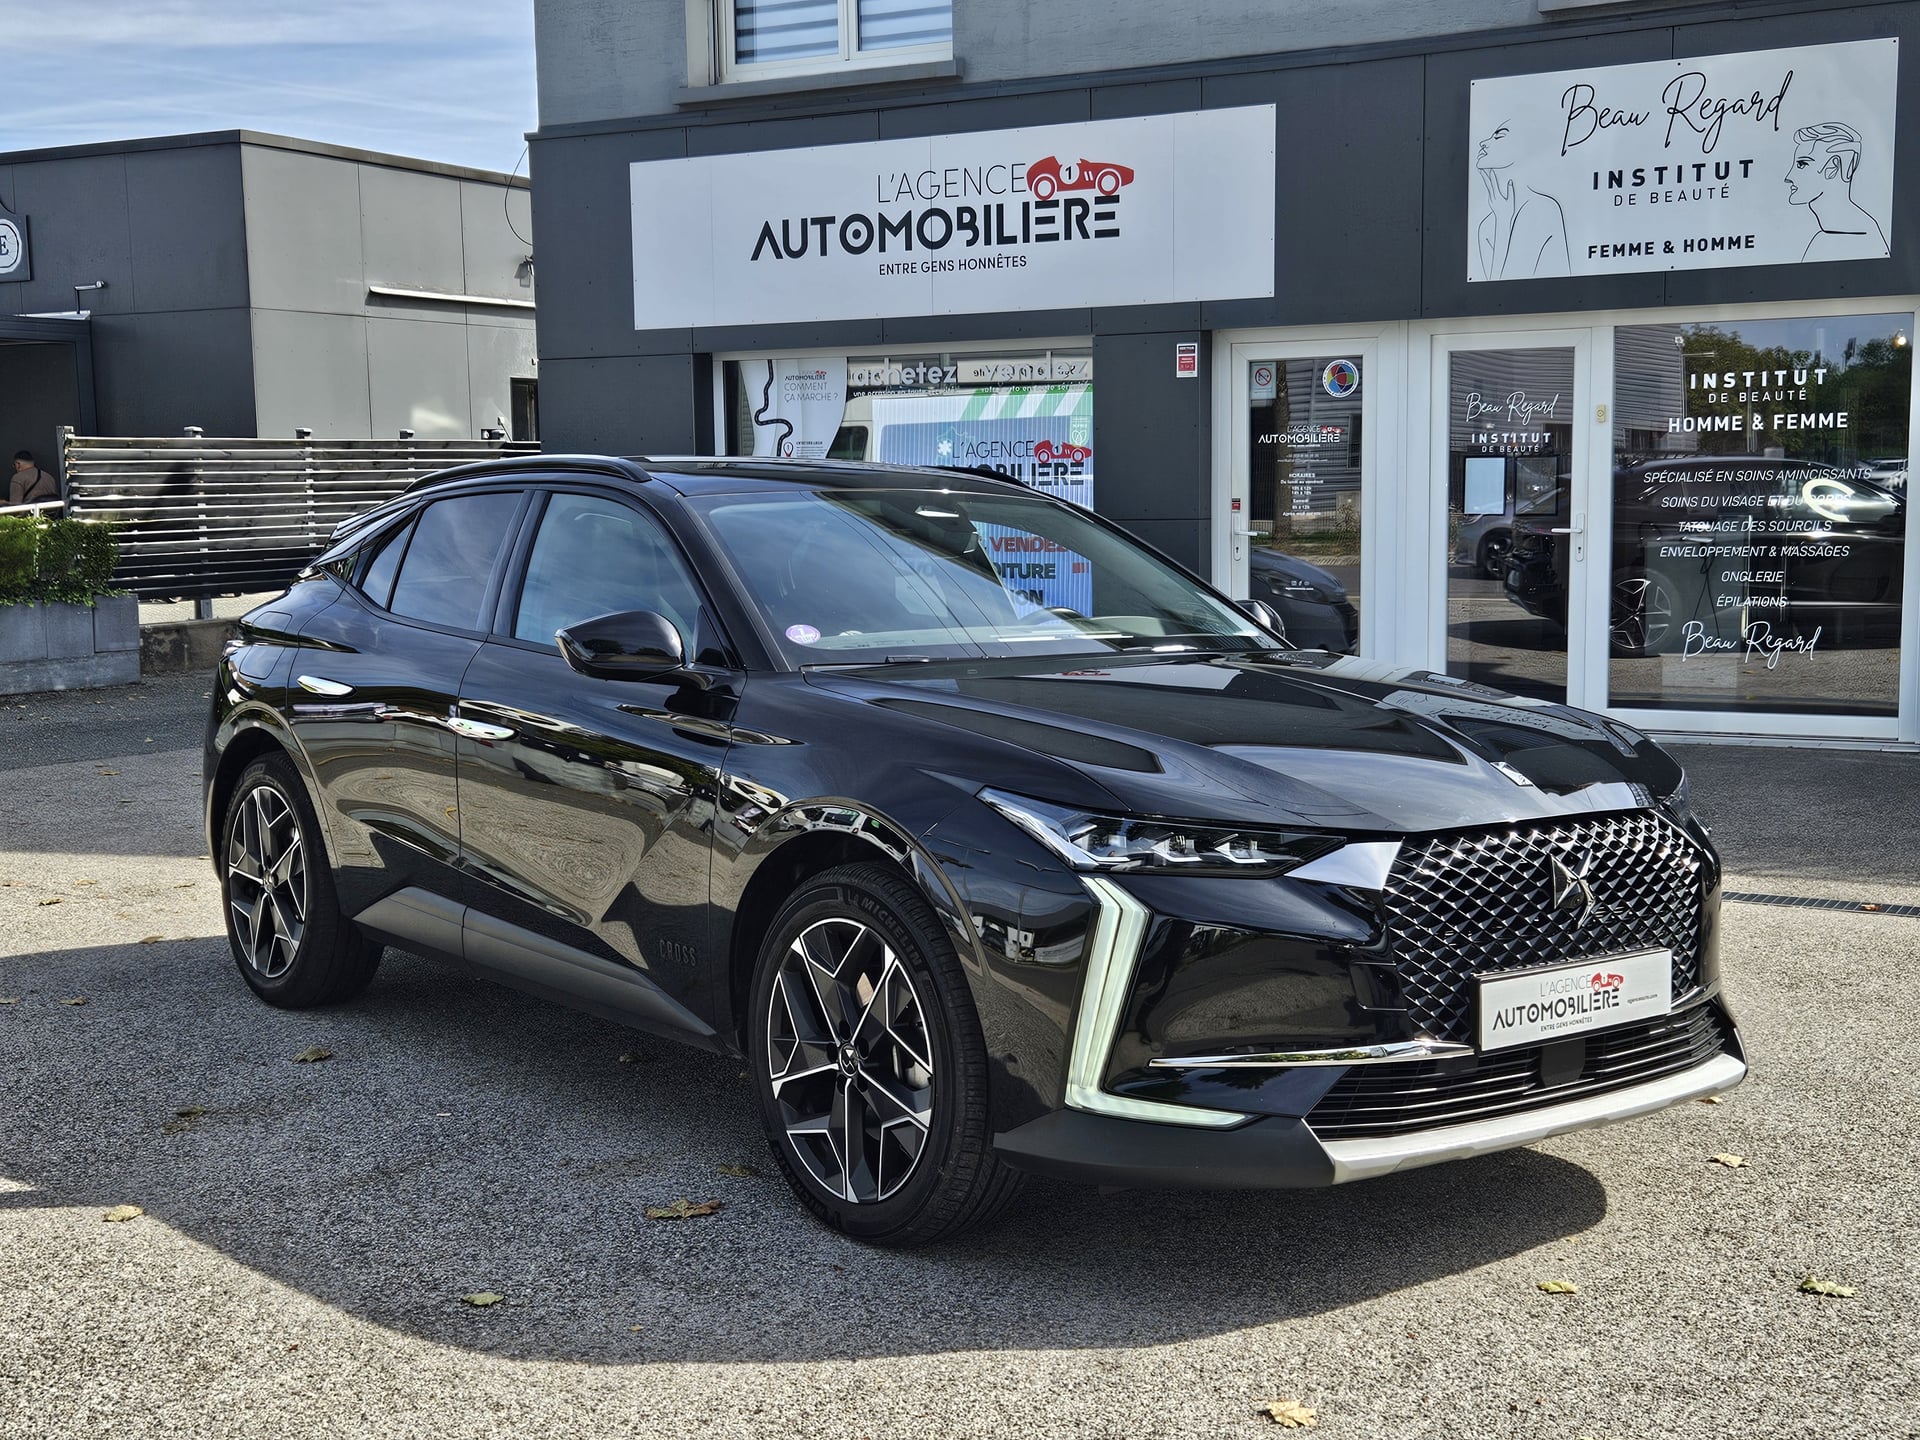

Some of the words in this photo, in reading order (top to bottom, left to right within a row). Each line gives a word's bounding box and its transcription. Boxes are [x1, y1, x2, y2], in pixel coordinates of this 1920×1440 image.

[1560, 83, 1649, 156] Beau
[1662, 70, 1794, 154] Regard
[877, 162, 1026, 204] L'AGENCE
[1593, 159, 1754, 190] INSTITUT
[1614, 193, 1637, 206] DE
[1650, 183, 1729, 204] BEAUTÉ
[1588, 241, 1654, 259] FEMME
[1663, 240, 1675, 254] &
[1683, 235, 1755, 253] HOMME
[879, 262, 917, 275] ENTRE
[920, 260, 954, 273] GENS
[958, 253, 1027, 271] HONNÊTES
[853, 357, 957, 386] achetez
[1690, 368, 1828, 390] INSTITUT
[784, 382, 827, 391] COMMENT
[797, 392, 831, 401] MARCHE
[1708, 392, 1729, 404] DE
[1739, 387, 1807, 403] BEAUTÉ
[1466, 392, 1503, 423] Beau
[1506, 391, 1559, 426] Regard
[1668, 415, 1743, 433] HOMME
[1752, 413, 1764, 431] &
[1773, 412, 1848, 430] FEMME
[1471, 432, 1551, 444] INSTITUT
[1482, 445, 1494, 453] DE
[1500, 443, 1539, 453] BEAUTÉ
[952, 440, 1034, 458] L'AGENCE
[1643, 468, 1714, 483] SPÉCIALISÉ
[1716, 470, 1734, 482] EN
[1735, 470, 1774, 481] SOINS
[1775, 468, 1872, 481] AMINCISSANTS
[1661, 496, 1698, 508] SOINS
[1701, 496, 1718, 507] DU
[1722, 495, 1765, 507] VISAGE
[1767, 495, 1784, 506] ET
[1679, 521, 1739, 533] TATOUAGE
[1741, 520, 1766, 532] DES
[1768, 520, 1832, 532] SOURCILS
[1660, 545, 1767, 557] ENVELOPPEMENT
[1768, 545, 1777, 557] &
[1780, 545, 1850, 557] MASSAGES
[1721, 570, 1784, 583] ONGLERIE
[1716, 594, 1788, 608] ÉPILATIONS
[1682, 620, 1737, 662] Beau
[1745, 620, 1822, 669] Regard
[660, 939, 697, 967] CROSS
[1540, 974, 1591, 998] L'AGENCE
